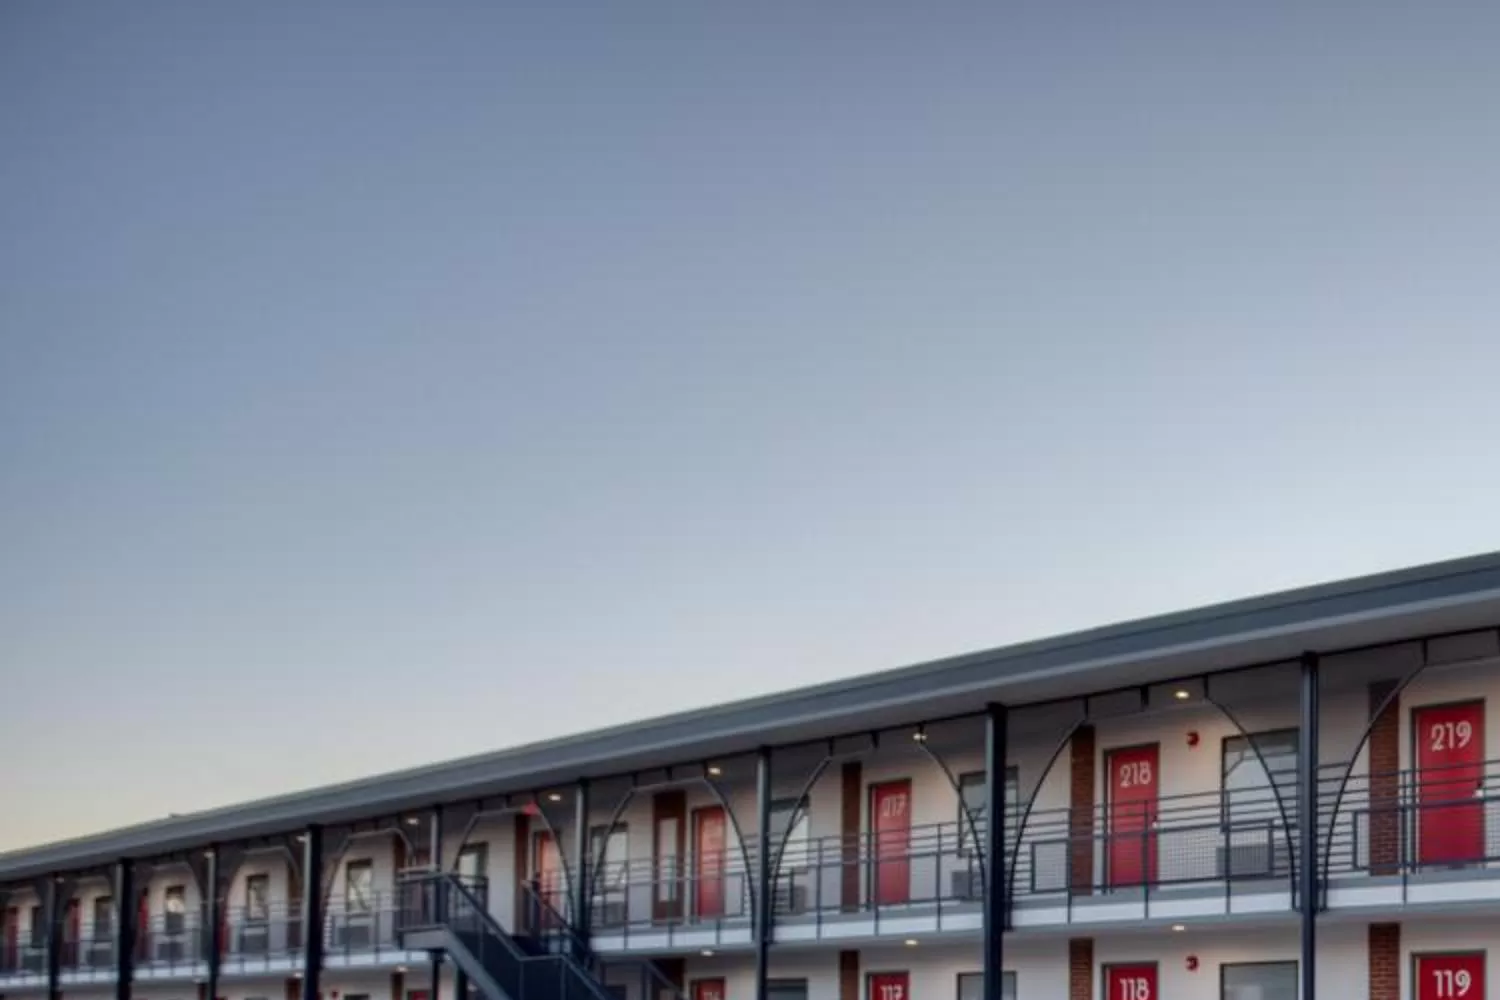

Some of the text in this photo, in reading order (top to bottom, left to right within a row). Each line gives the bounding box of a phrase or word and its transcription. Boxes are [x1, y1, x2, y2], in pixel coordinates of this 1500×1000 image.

[1431, 720, 1472, 752] 219
[1120, 761, 1151, 788] 218
[1432, 969, 1472, 999] 119
